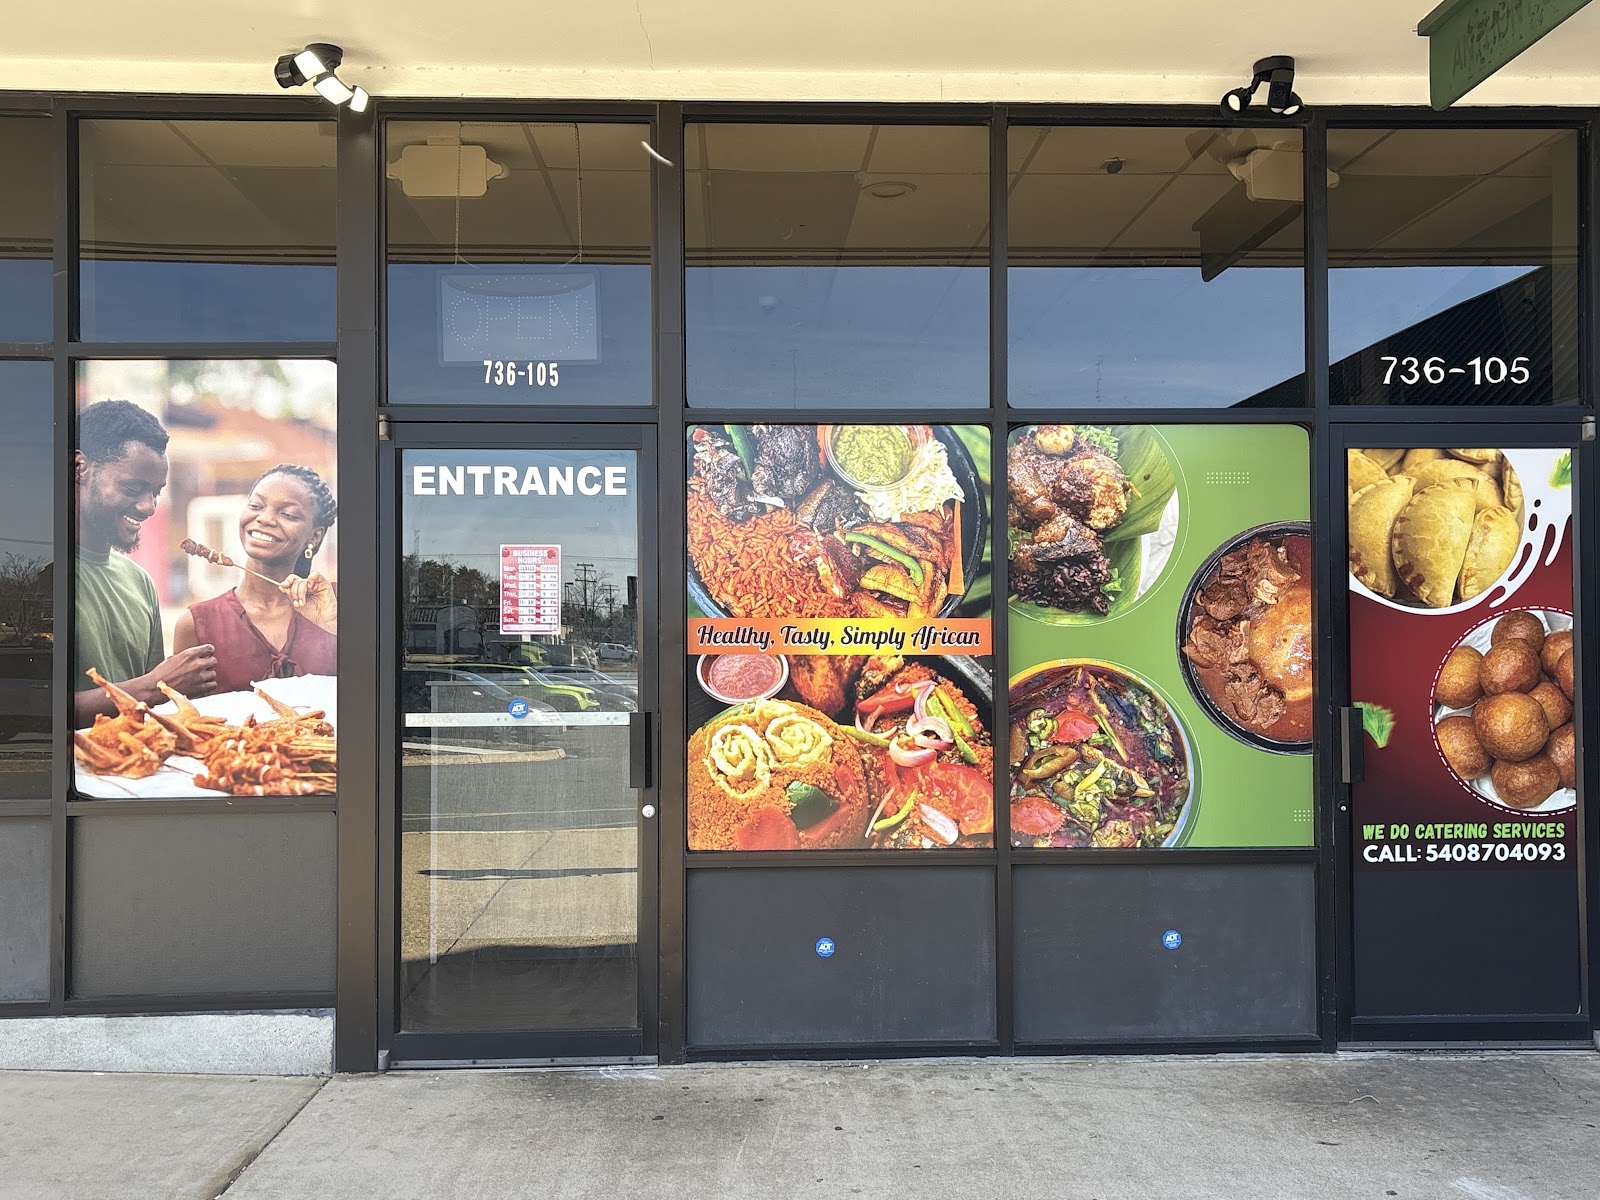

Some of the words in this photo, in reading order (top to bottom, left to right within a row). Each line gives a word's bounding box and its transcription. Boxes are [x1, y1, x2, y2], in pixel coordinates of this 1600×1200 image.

[452, 296, 578, 340] OPEN
[483, 360, 559, 387] 736-105
[1380, 356, 1530, 386] 736-105
[413, 465, 627, 496] ENTRANCE
[512, 549, 548, 557] BUSINESS
[697, 625, 775, 651] Healthy,
[780, 625, 835, 650] Tasty,
[840, 625, 906, 650] Simply
[910, 625, 980, 648] African
[1362, 824, 1385, 840] WE
[1390, 824, 1410, 840] DO
[1415, 823, 1488, 839] CATERING
[1492, 822, 1566, 839] SERVICES
[1362, 844, 1422, 863] CALL:
[1425, 843, 1566, 862] 5408704093
